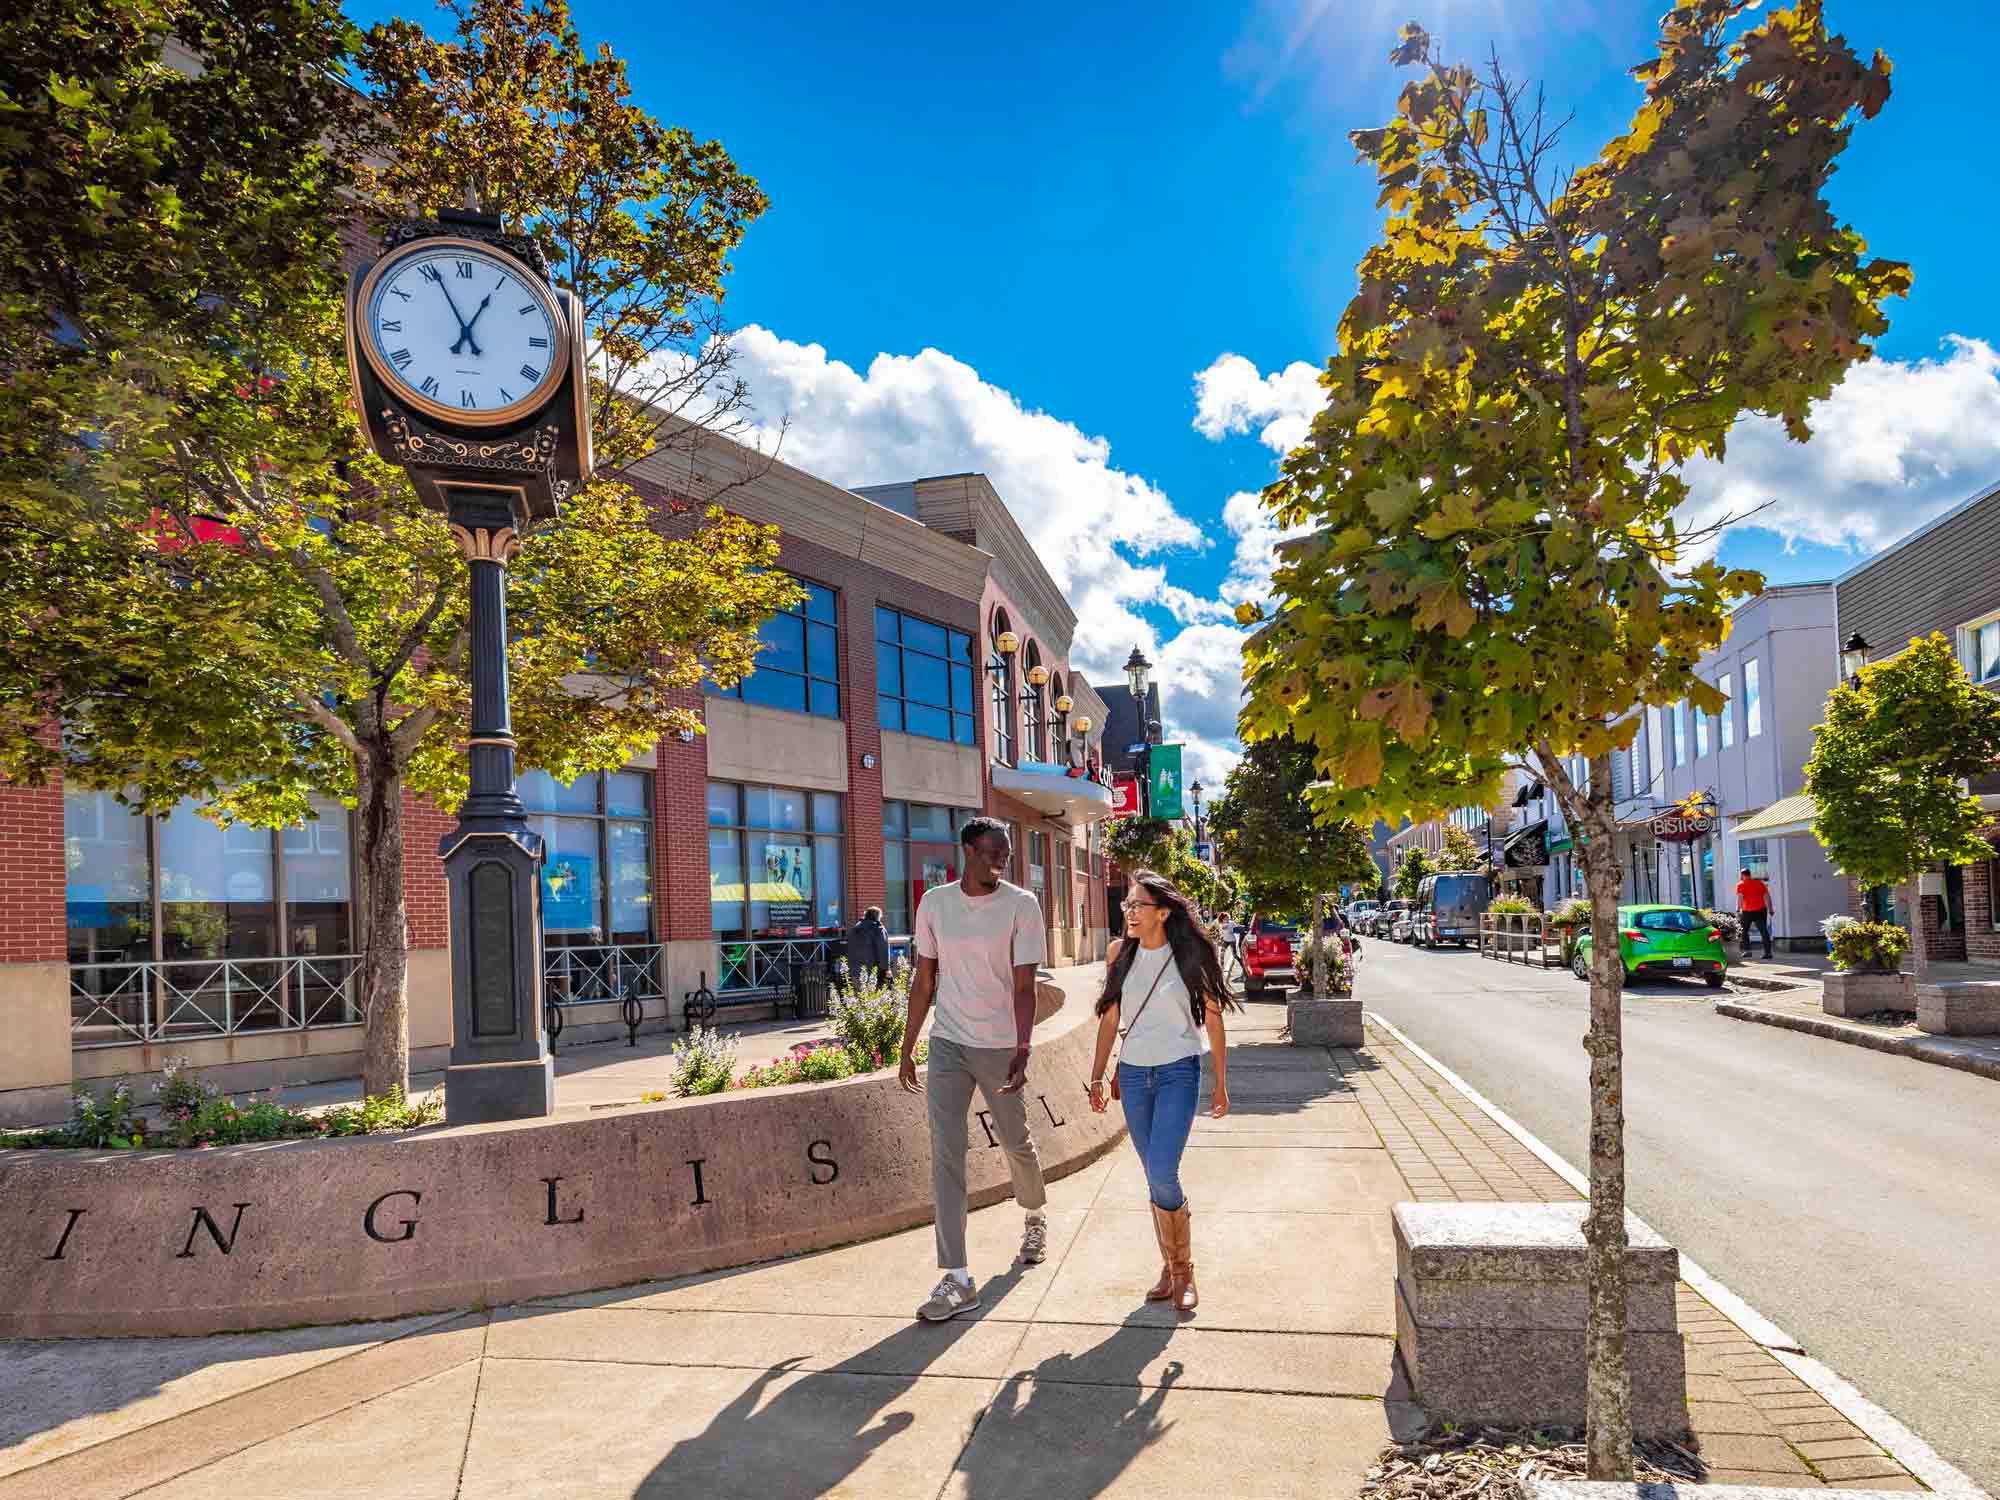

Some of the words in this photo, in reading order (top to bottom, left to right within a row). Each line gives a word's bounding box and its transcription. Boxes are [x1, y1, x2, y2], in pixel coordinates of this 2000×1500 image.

[456, 260, 473, 279] XII
[495, 276, 506, 291] I
[390, 285, 411, 302] X
[519, 304, 537, 316] II
[381, 318, 401, 333] IX
[529, 336, 548, 348] III
[390, 348, 413, 371] VIII
[519, 364, 541, 383] IIII
[419, 376, 440, 397] VII
[461, 389, 476, 408] VI
[500, 388, 513, 404] V
[43, 1138, 840, 1262] INGLIS
